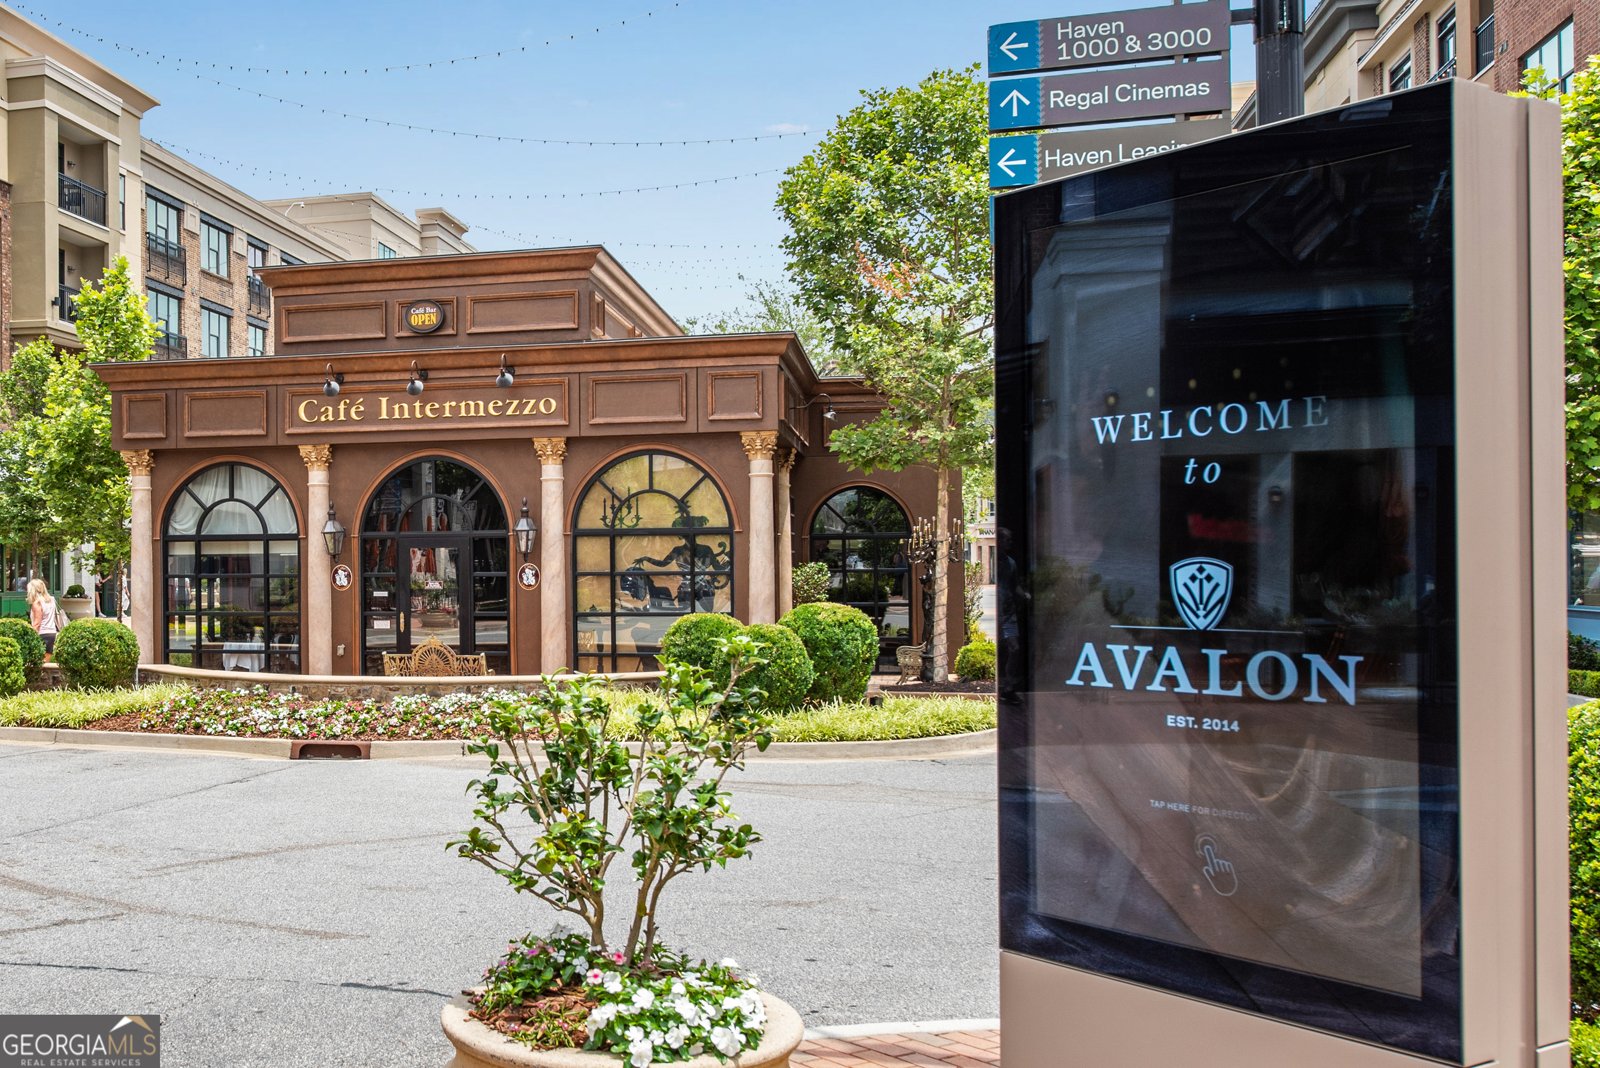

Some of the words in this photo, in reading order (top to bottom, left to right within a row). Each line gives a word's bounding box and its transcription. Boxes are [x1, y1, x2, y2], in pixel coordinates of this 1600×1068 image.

[1057, 21, 1124, 41] Haven
[1058, 37, 1119, 61] 1000
[1125, 35, 1142, 53] &
[1148, 27, 1211, 51] 3000
[1050, 85, 1109, 110] Regal
[1115, 82, 1210, 103] Cinemas
[1045, 148, 1112, 168] Haven
[411, 313, 437, 325] OPEN
[298, 398, 365, 423] Café
[378, 396, 557, 420] Intermezzo
[1091, 395, 1329, 444] WELCOME
[1184, 457, 1221, 484] to
[1065, 642, 1364, 706] AVALON
[1167, 714, 1198, 730] EST.
[1202, 717, 1240, 732] 2014
[1150, 799, 1165, 808] TAP
[1167, 802, 1190, 813] HERE
[1192, 805, 1210, 815] FOR
